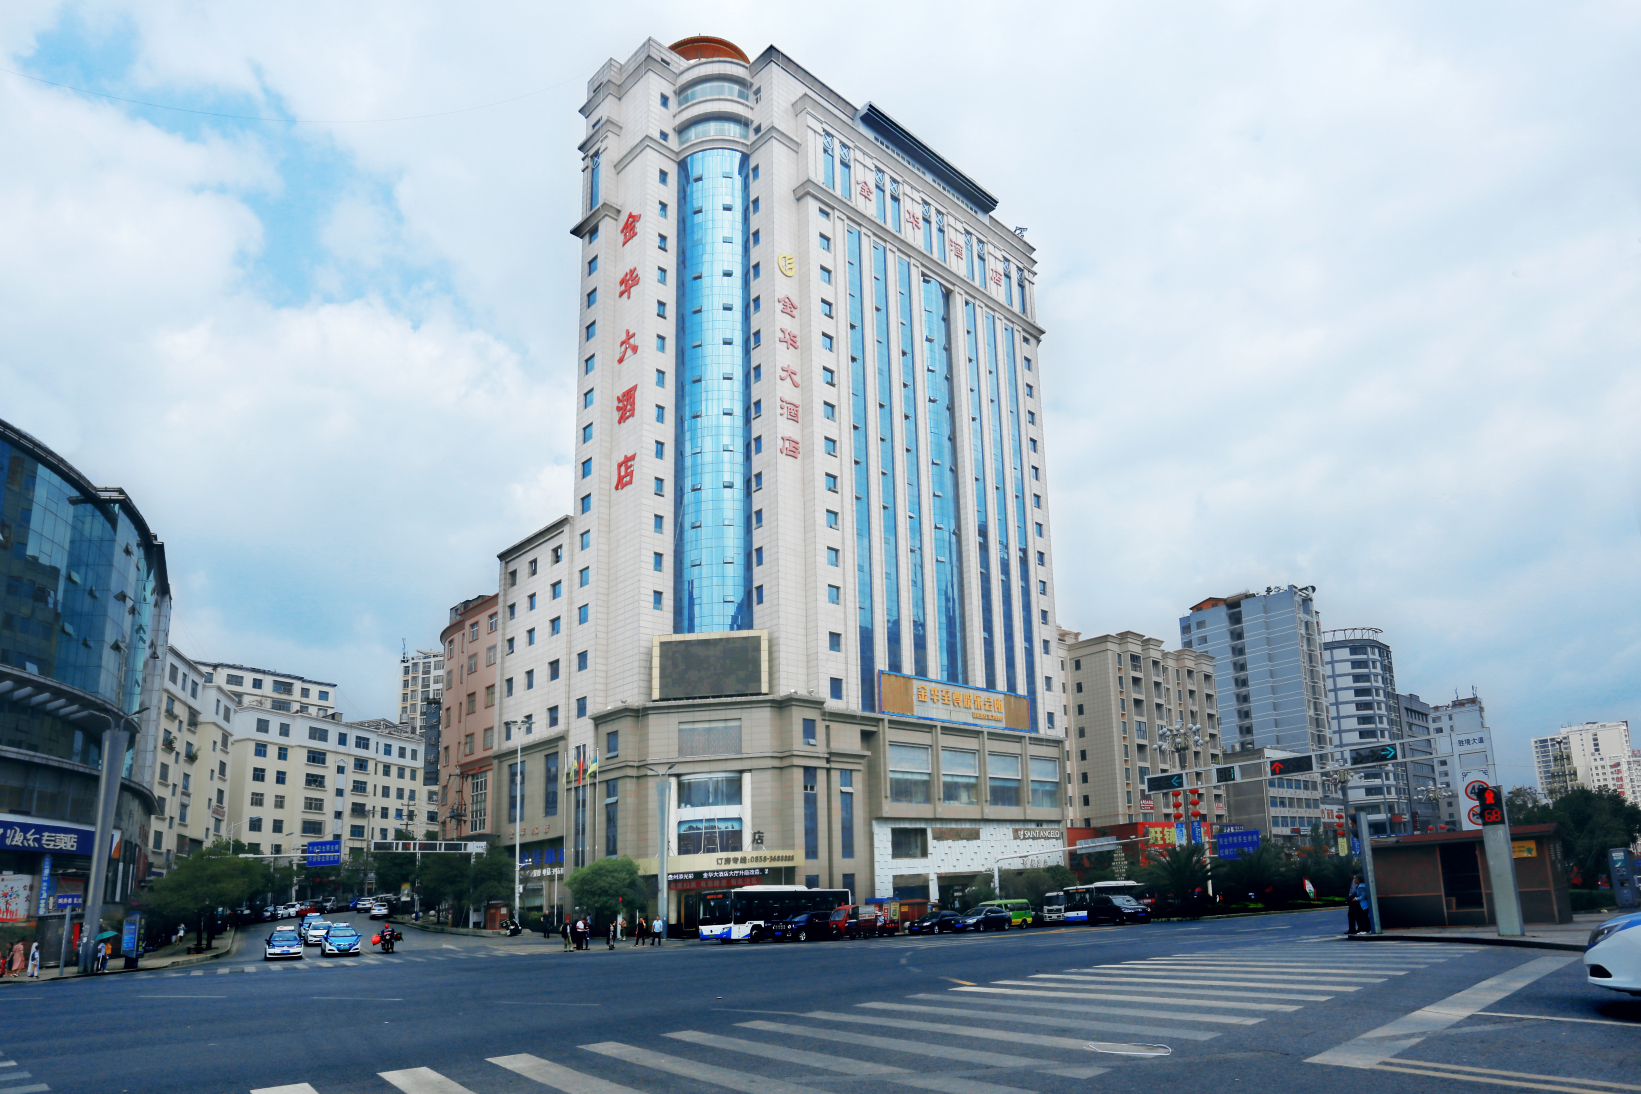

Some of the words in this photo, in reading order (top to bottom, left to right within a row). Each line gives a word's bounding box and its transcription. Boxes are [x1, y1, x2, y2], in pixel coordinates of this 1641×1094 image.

[614, 211, 642, 491] 金华大酒店
[777, 294, 801, 459] 金华大酒店
[917, 684, 1004, 713] 金华至尊娱乐会所
[1484, 809, 1502, 822] 68
[752, 830, 765, 845] 店
[1024, 830, 1039, 838] SAINT
[1040, 830, 1060, 838] ANGELO
